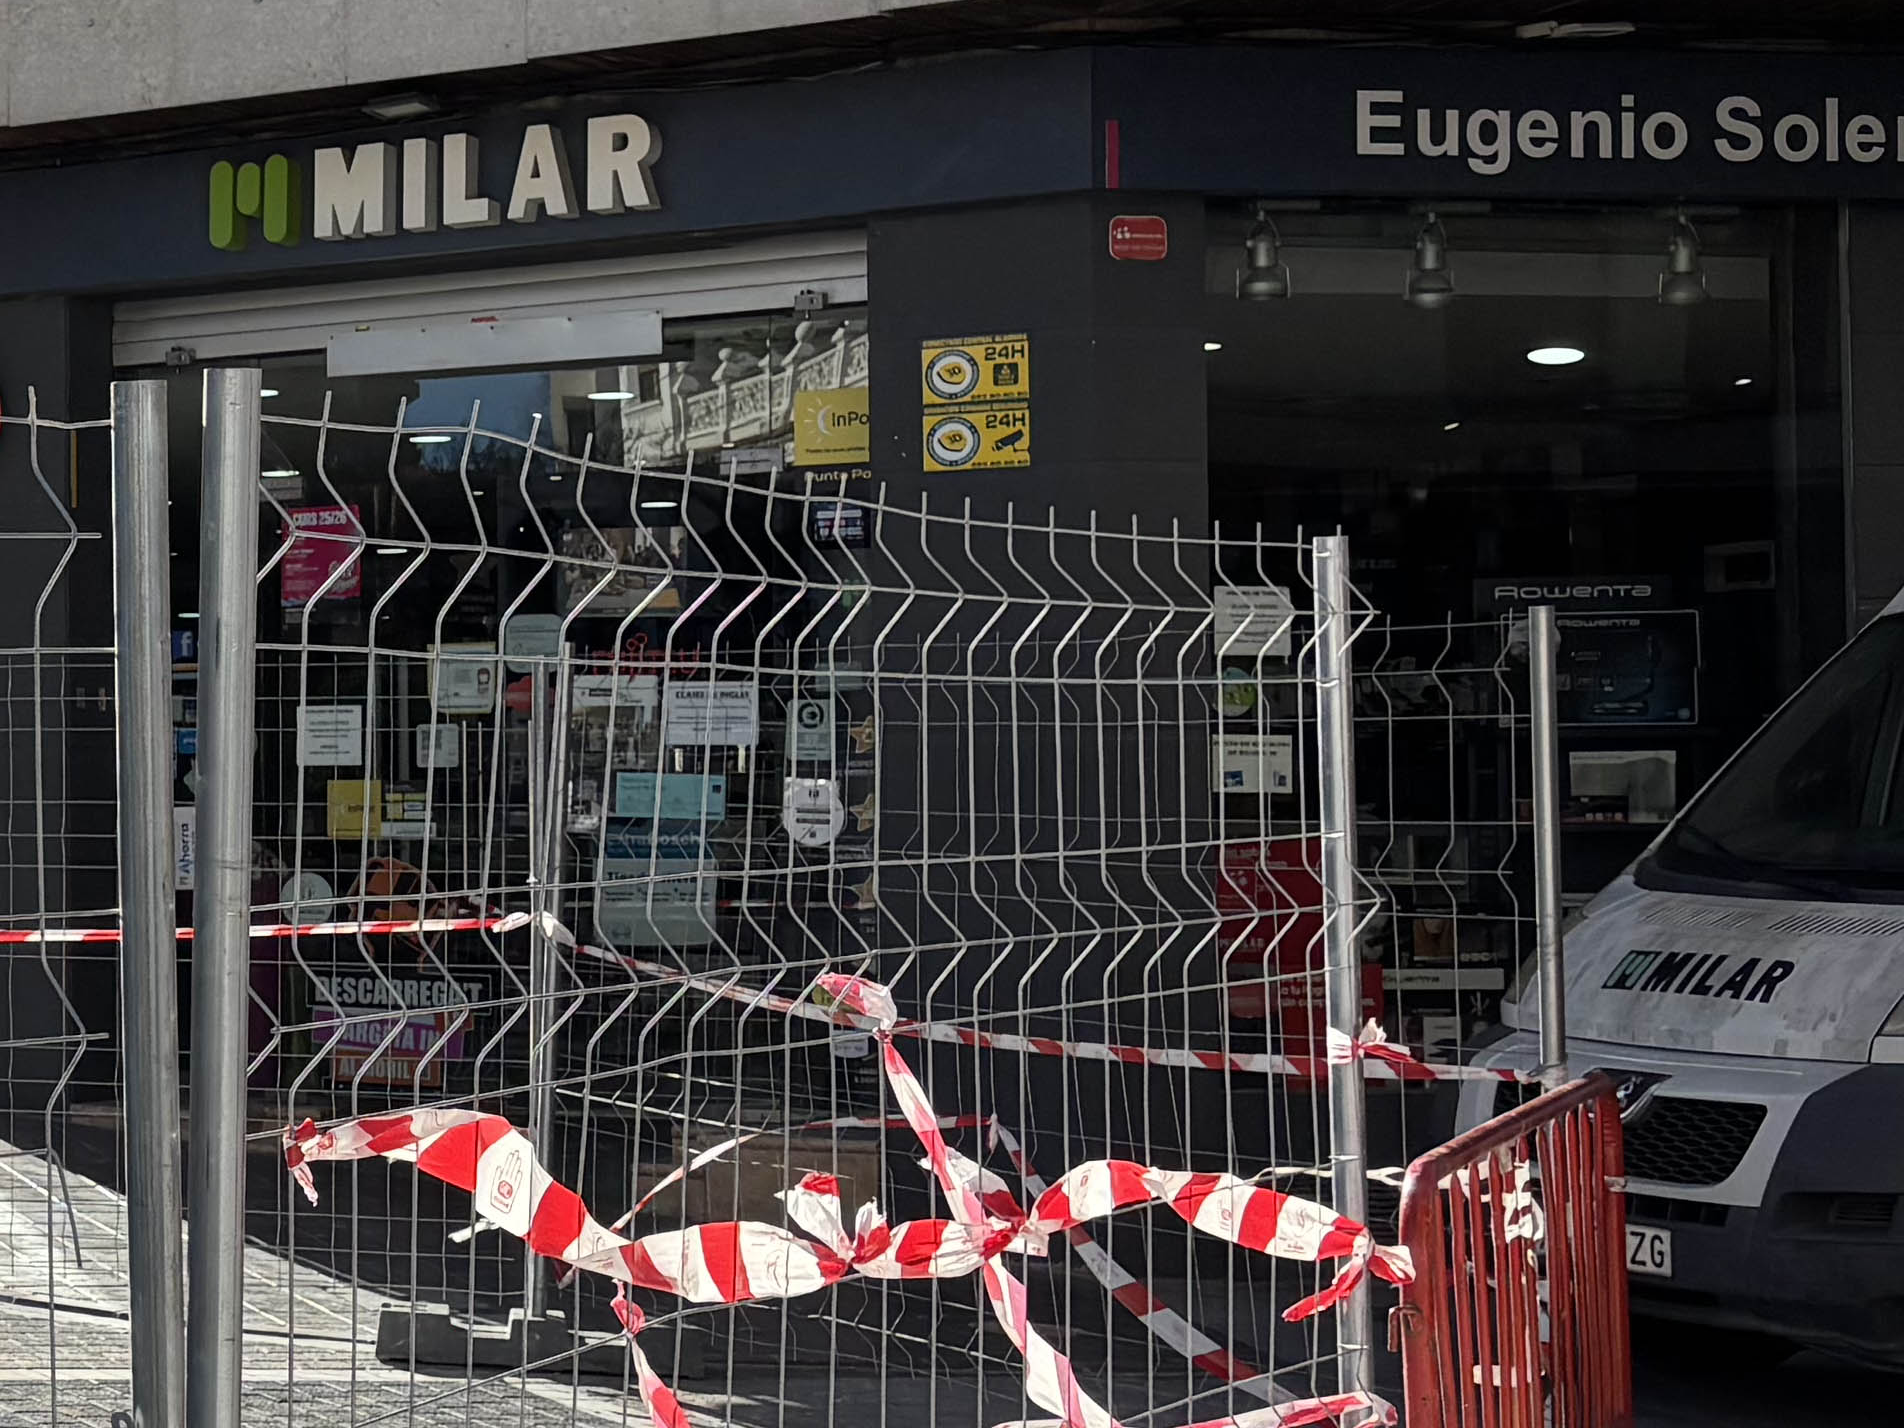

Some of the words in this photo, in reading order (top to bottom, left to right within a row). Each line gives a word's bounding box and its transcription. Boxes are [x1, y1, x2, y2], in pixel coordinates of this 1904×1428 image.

[1356, 89, 1689, 176] Eugenio
[313, 113, 658, 241] MILAR
[984, 343, 1025, 361] 24H
[831, 411, 869, 428] InPo
[985, 412, 1026, 429] 24H
[805, 471, 848, 482] Punt
[1646, 950, 1796, 1004] MILAR
[1629, 1230, 1665, 1269] ZG
